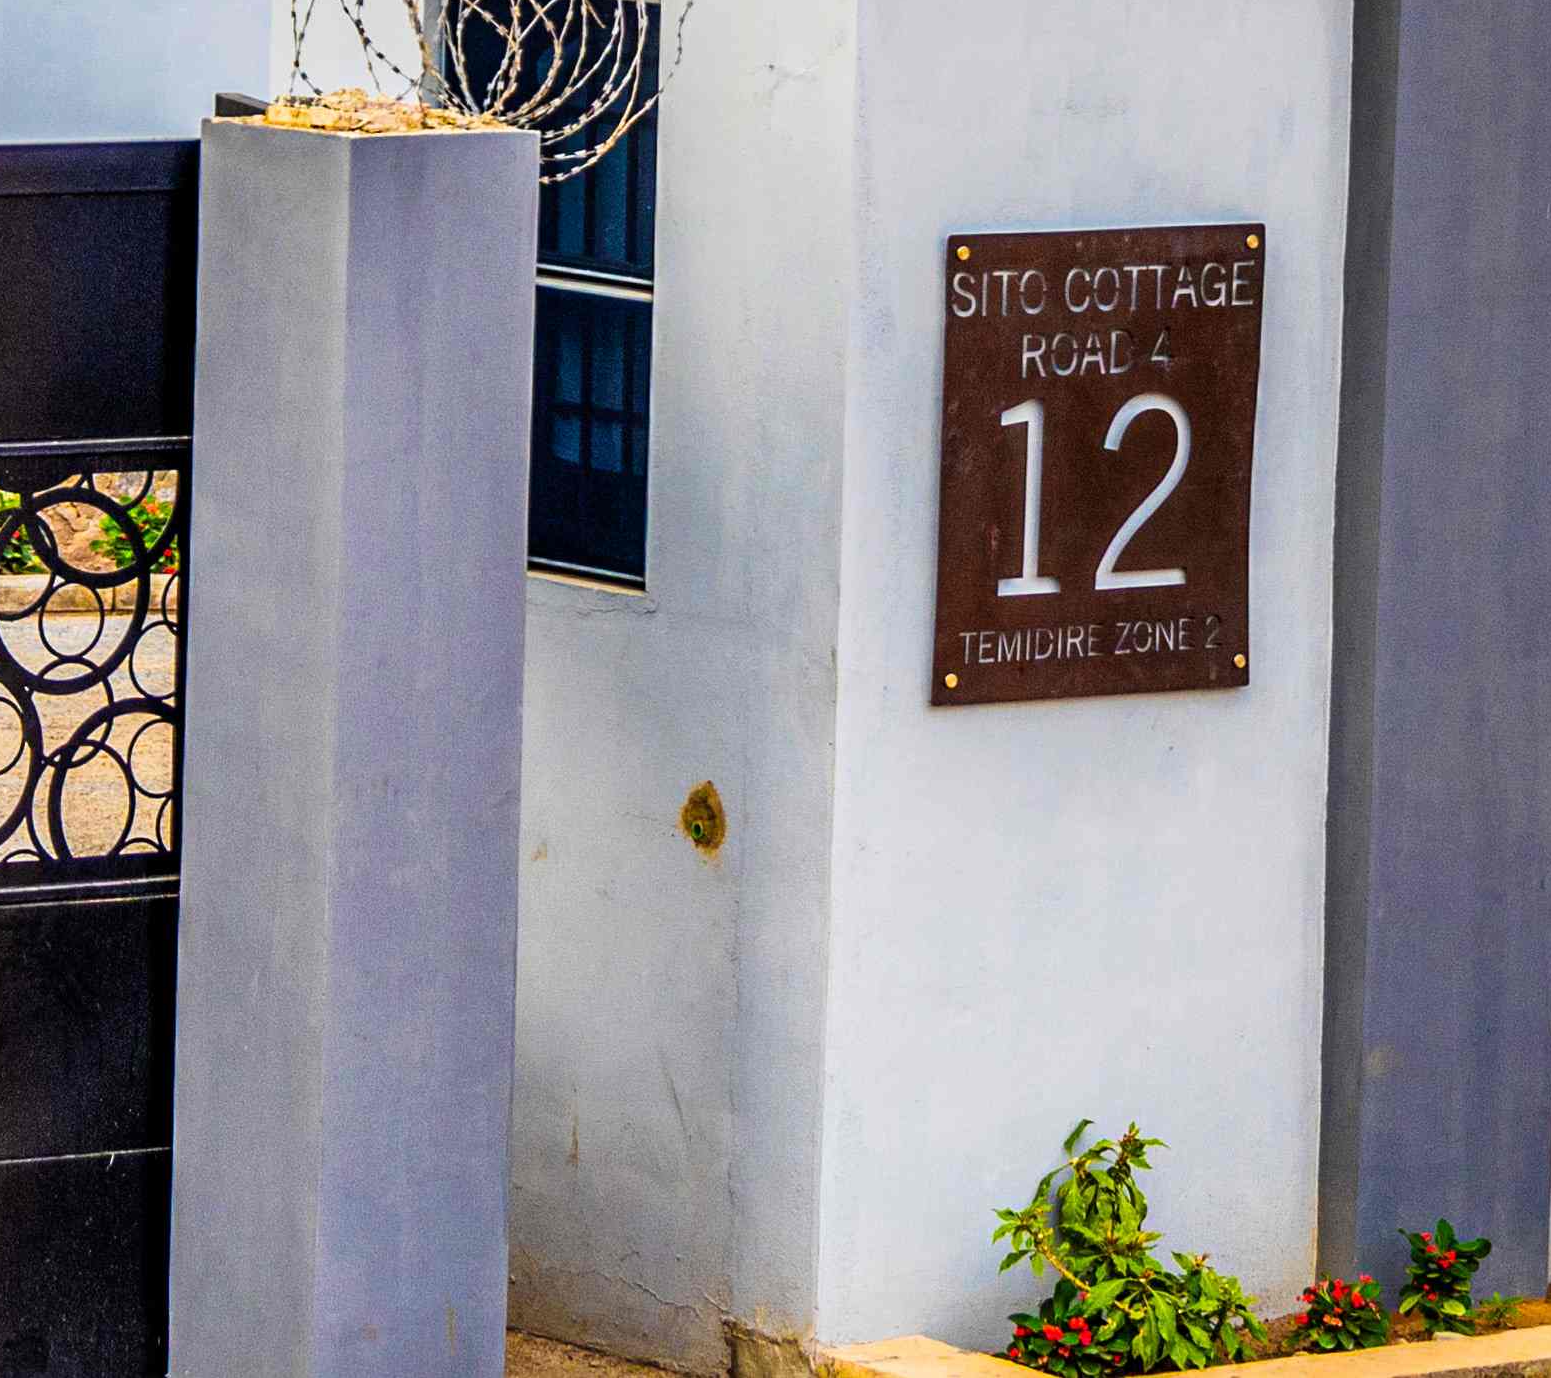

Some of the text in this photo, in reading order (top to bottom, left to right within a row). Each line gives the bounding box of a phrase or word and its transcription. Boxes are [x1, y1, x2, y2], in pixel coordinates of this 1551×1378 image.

[951, 260, 1256, 318] SITO COTTAGE
[1021, 329, 1173, 379] ROAD 4
[997, 391, 1193, 597] 12
[959, 615, 1224, 665] TEMIDIRE ZONE 2
